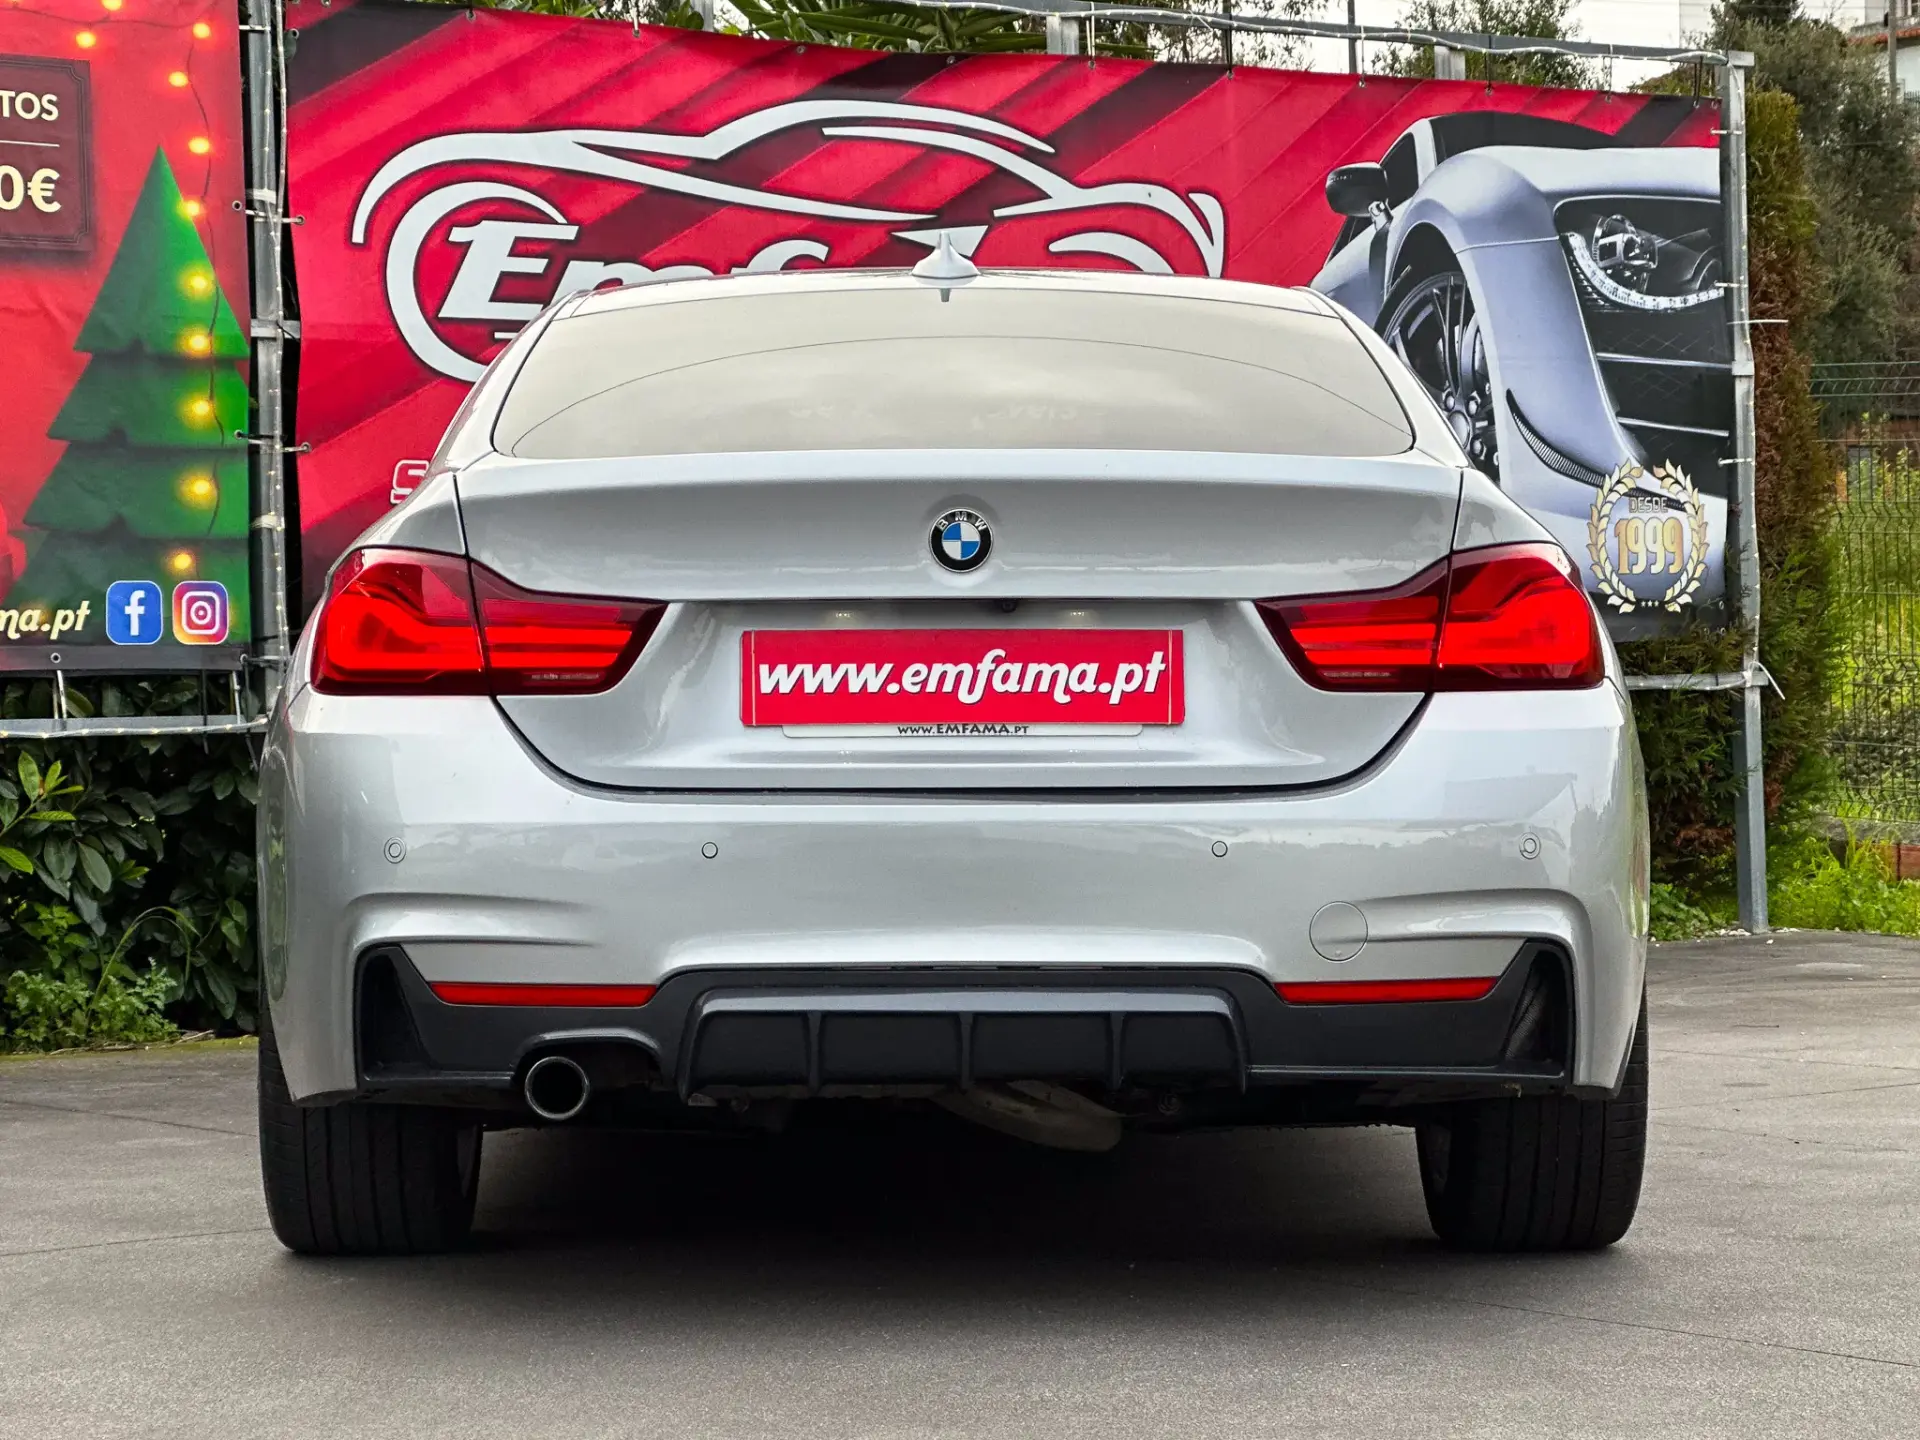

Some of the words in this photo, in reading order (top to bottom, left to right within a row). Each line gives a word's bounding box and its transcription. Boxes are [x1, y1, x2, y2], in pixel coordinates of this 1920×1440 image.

[0, 90, 59, 121] TOS
[1628, 497, 1669, 513] DESDE
[935, 511, 988, 531] BMW
[1614, 516, 1685, 575] 1999
[757, 648, 1168, 705] www.emfama.pt
